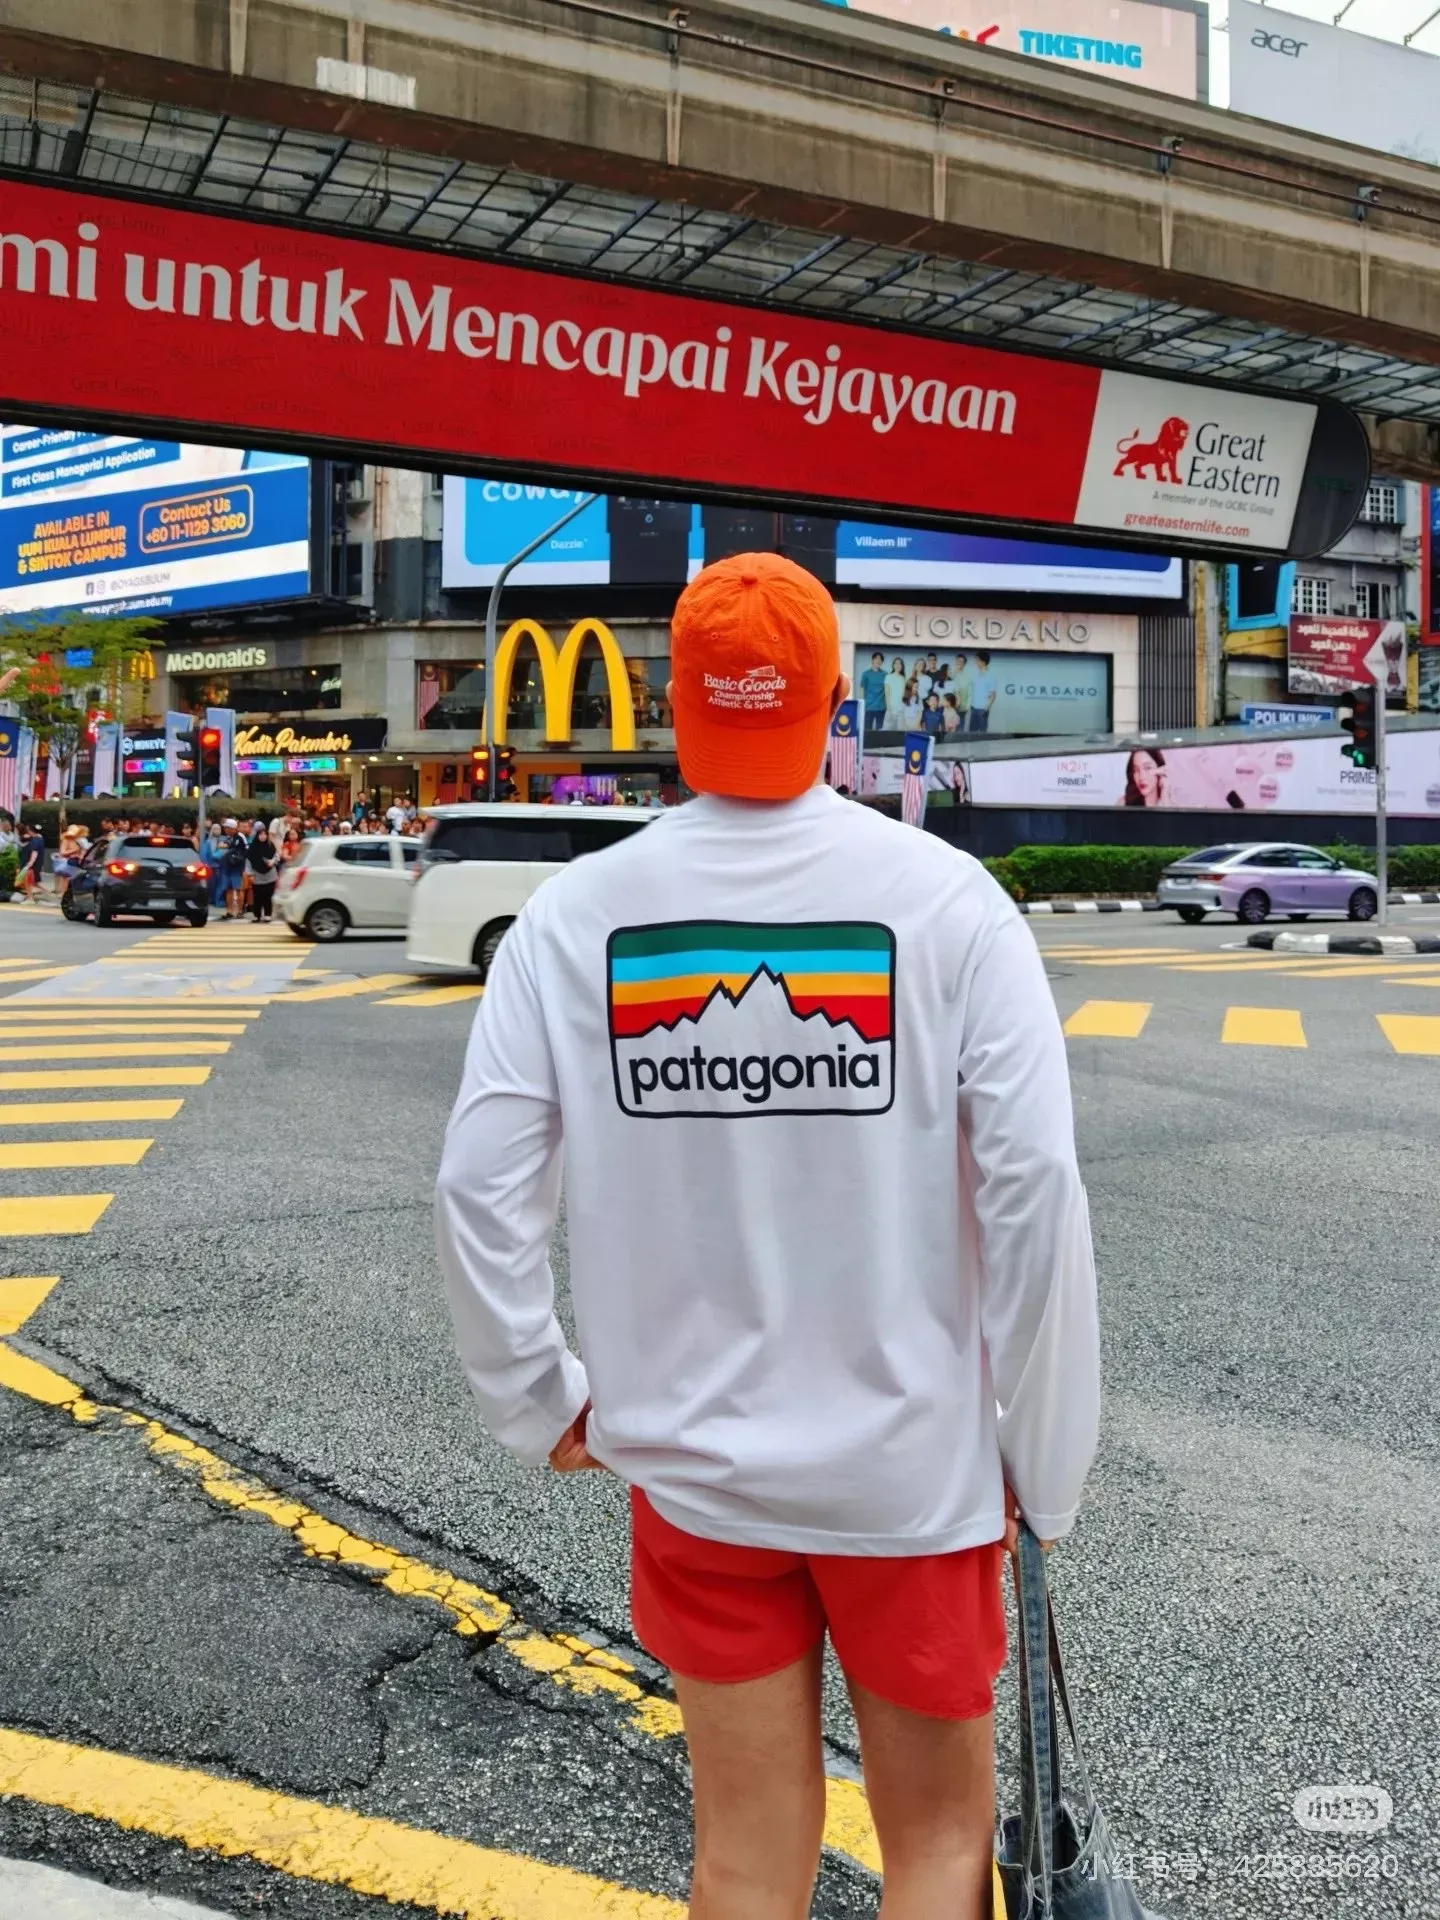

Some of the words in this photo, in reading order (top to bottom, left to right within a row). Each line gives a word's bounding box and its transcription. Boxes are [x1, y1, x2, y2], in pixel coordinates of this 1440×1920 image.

[1019, 30, 1142, 69] TIKETING
[1251, 27, 1308, 58] acer
[124, 253, 368, 341] untuk
[385, 278, 732, 398] Mencapai
[744, 336, 1016, 434] Kejayaan
[1195, 422, 1267, 461] Great
[12, 476, 30, 489] First
[31, 471, 55, 485] Class
[56, 457, 104, 478] Managerial
[105, 447, 156, 468] Application
[1187, 456, 1280, 498] Eastern
[160, 500, 212, 523] Contact
[213, 497, 231, 514] Us
[1162, 492, 1197, 505] member
[1198, 496, 1209, 506] of
[1209, 497, 1223, 510] the
[1250, 503, 1275, 516] Group
[34, 514, 96, 539] AVAILABLE
[97, 510, 110, 526] IN
[146, 527, 168, 544] +60
[170, 518, 210, 541] 11-1129
[211, 512, 247, 532] 3060
[1124, 512, 1250, 537] greateasternlife.com
[44, 534, 79, 555] KUALA
[80, 526, 126, 548] LUMPUR
[855, 535, 895, 548] Villaem
[28, 552, 72, 573] SINTOK
[73, 542, 127, 565] CAMPUS
[879, 612, 1090, 643] GIORDANO
[166, 647, 267, 672] McDonald's
[704, 672, 738, 690] Basic
[738, 675, 786, 693] Goods
[714, 690, 775, 702] Championship
[1004, 683, 1098, 697] GIORDANO
[708, 696, 742, 708] Athletic
[743, 700, 753, 709] &
[754, 700, 783, 711] Sports
[234, 725, 276, 756] Kadir
[275, 727, 352, 755] Pasembor
[1057, 777, 1087, 786] PRIMER
[1340, 771, 1377, 784] PRIME
[628, 1044, 880, 1105] patagonia
